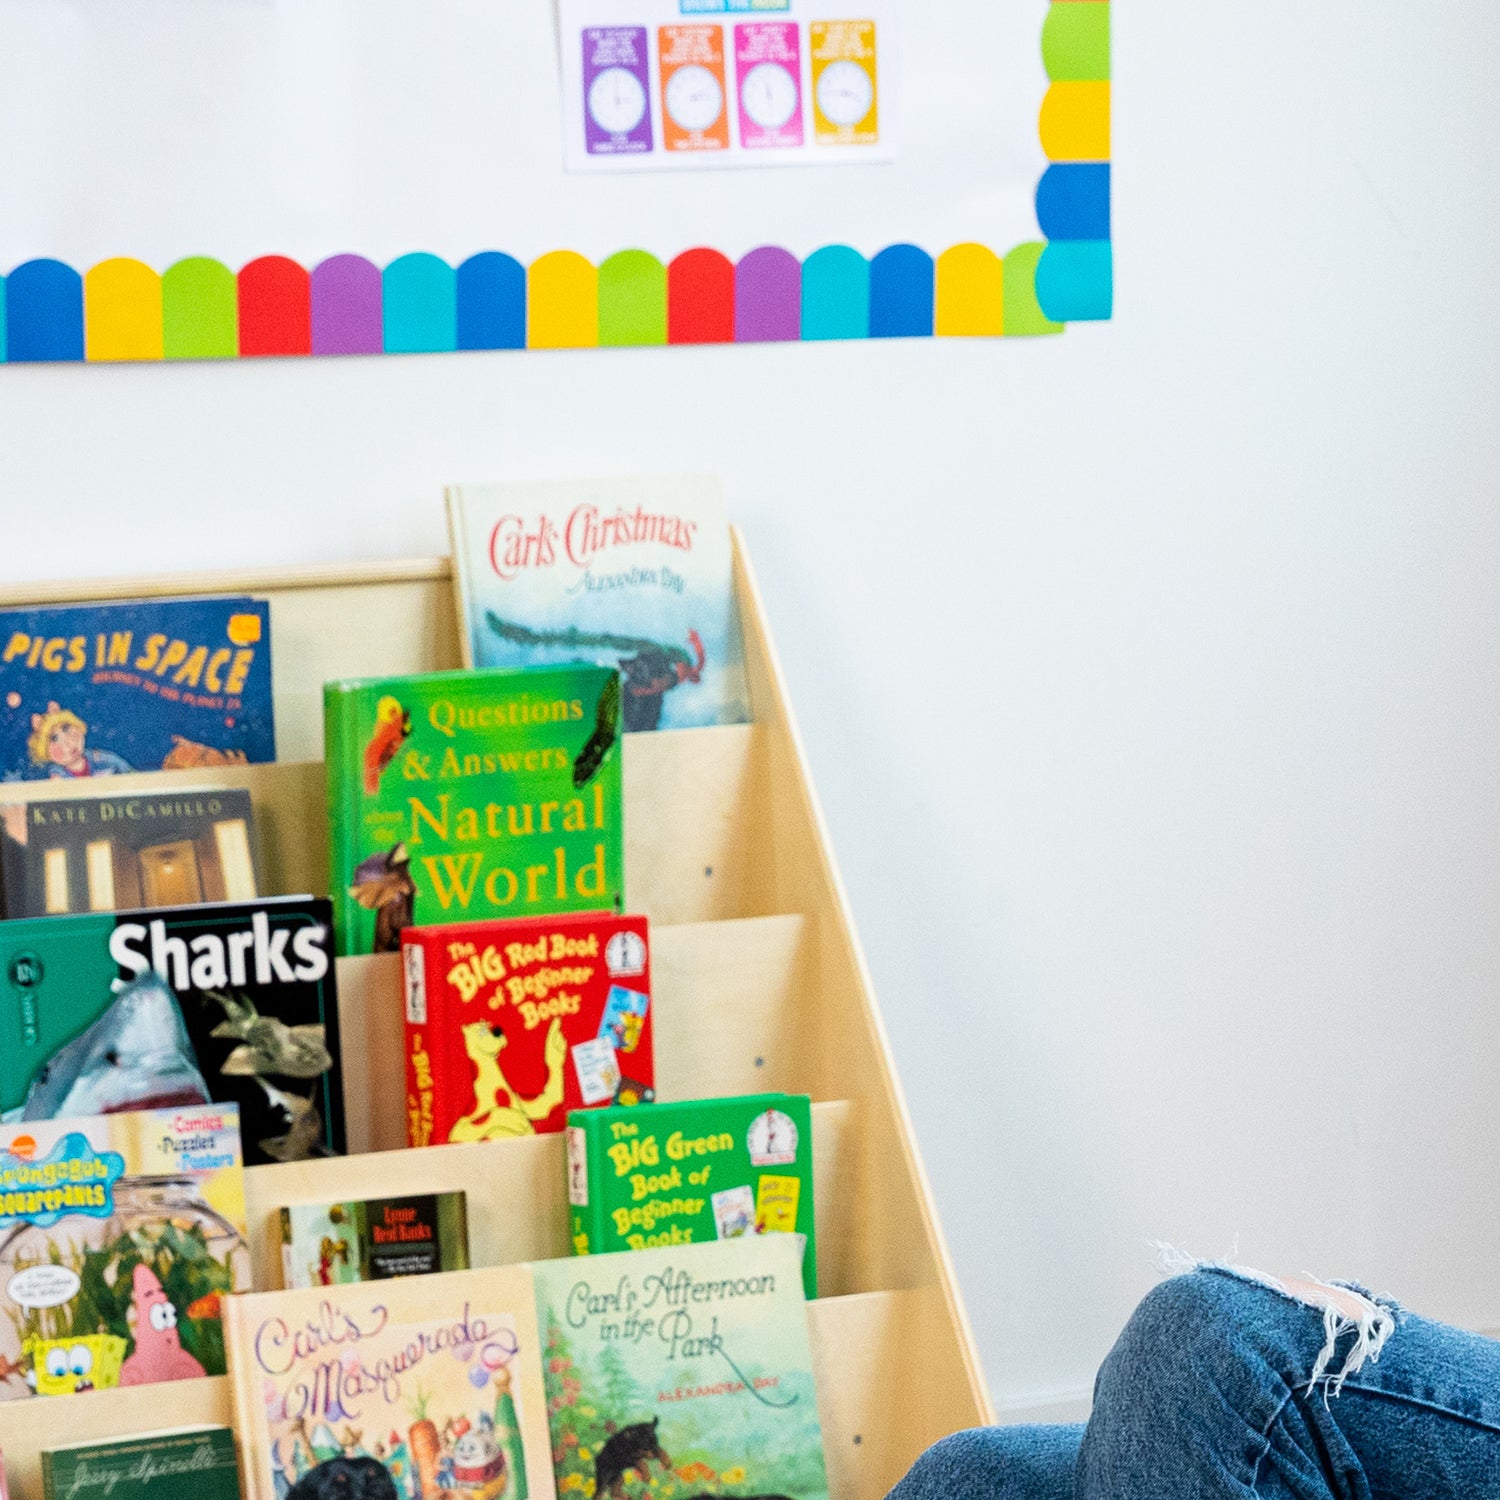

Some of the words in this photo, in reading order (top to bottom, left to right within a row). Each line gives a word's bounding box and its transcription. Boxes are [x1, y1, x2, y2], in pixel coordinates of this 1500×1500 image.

[563, 503, 697, 569] Christmas
[3, 632, 87, 673] PIGS
[95, 630, 134, 667] IN
[135, 632, 254, 695] SPACE
[428, 693, 584, 737] Questions
[402, 750, 431, 781] &
[439, 746, 569, 779] Answers
[408, 783, 605, 845] Natural
[421, 844, 607, 911] World
[108, 910, 329, 994] Sharks
[446, 941, 477, 960] The
[446, 945, 506, 1003] BIG
[505, 935, 548, 969] Red
[549, 933, 599, 960] Book
[487, 985, 506, 1010] of
[505, 966, 595, 1005] Beginner
[517, 990, 582, 1030] Books
[610, 1122, 639, 1140] The
[607, 1135, 660, 1177] BIG
[666, 1131, 734, 1161] Green
[629, 1165, 682, 1200] Book
[688, 1165, 712, 1185] of
[611, 1198, 706, 1236] Beginner
[626, 1223, 694, 1252] Books
[565, 1273, 638, 1329] Carl's
[642, 1266, 776, 1309] Afternoon
[254, 1299, 389, 1376] Carl's
[600, 1319, 620, 1342] in
[622, 1309, 655, 1344] the
[281, 1301, 519, 1421] Masquerade
